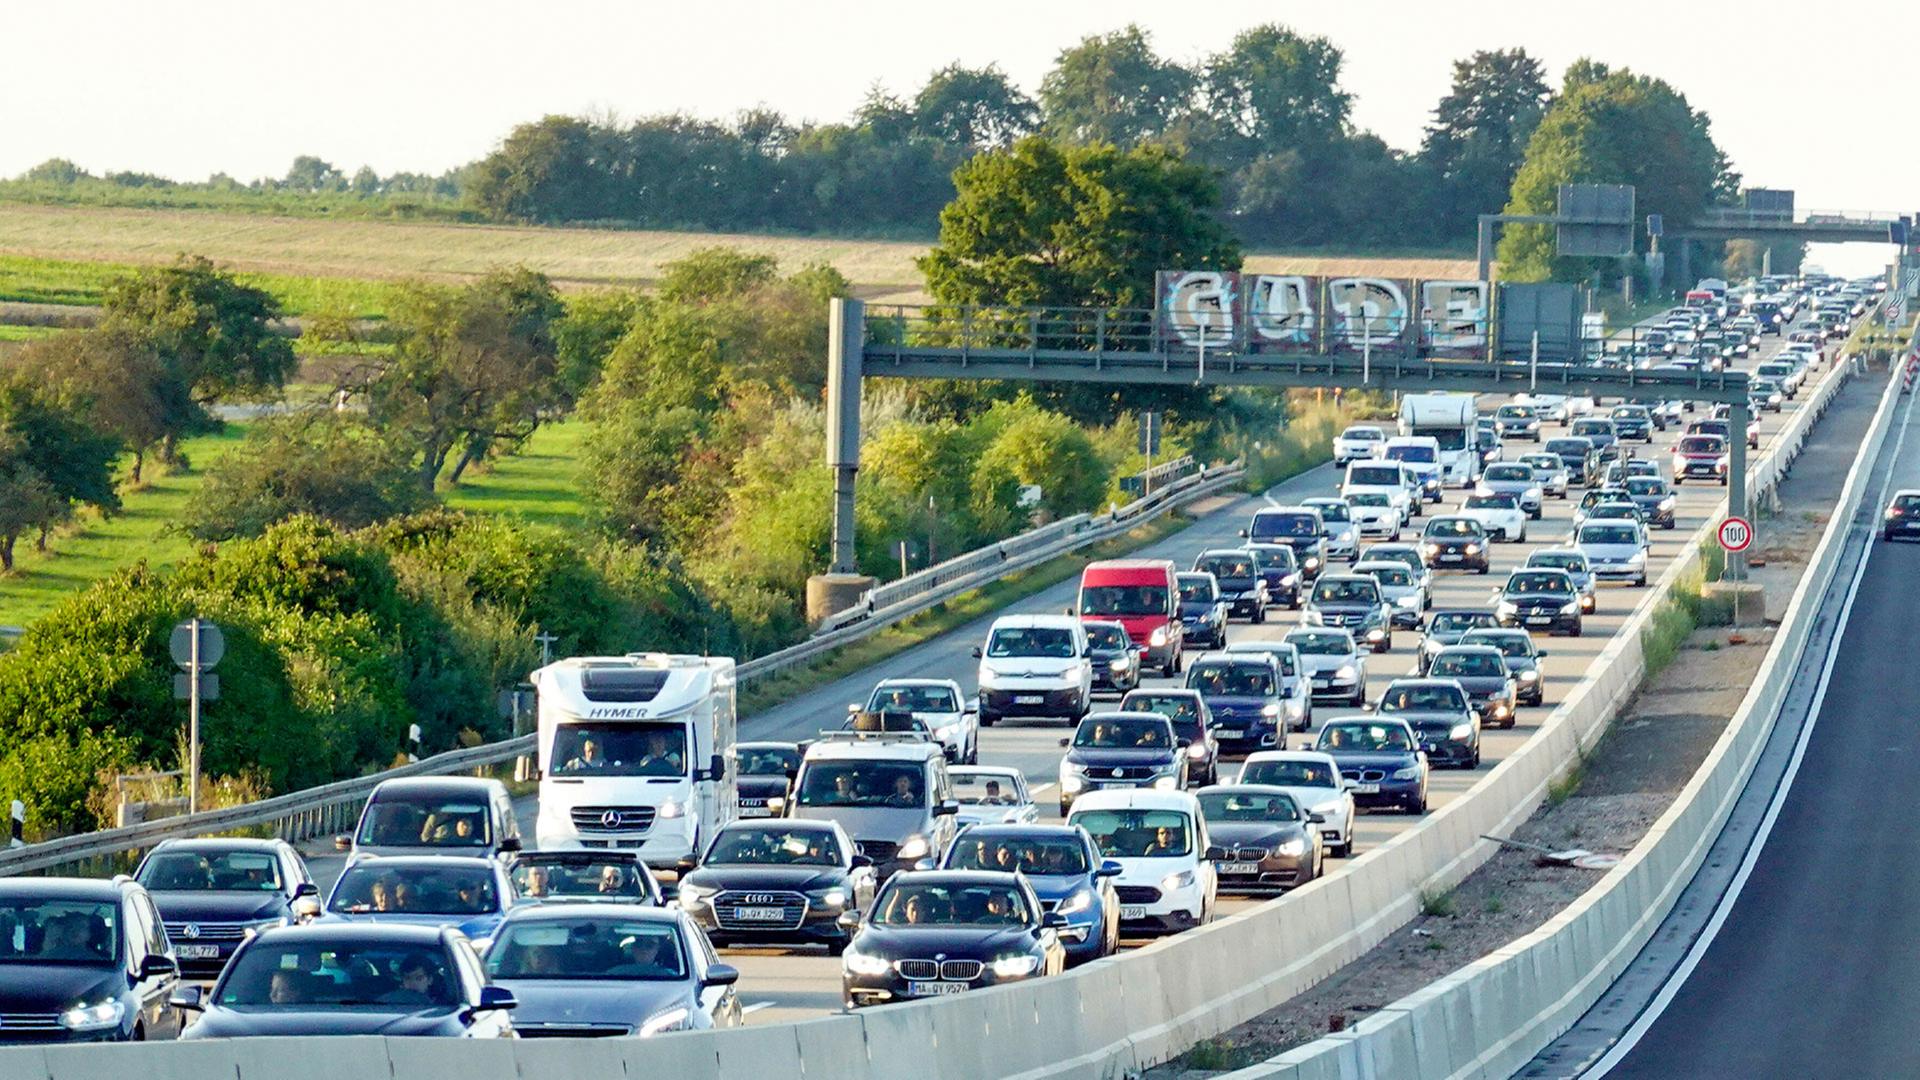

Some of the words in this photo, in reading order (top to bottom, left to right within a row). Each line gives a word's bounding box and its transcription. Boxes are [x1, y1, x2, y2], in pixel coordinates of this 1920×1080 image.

[1168, 271, 1489, 348] GUDE
[1725, 527, 1745, 542] 100
[590, 708, 648, 718] HYMER
